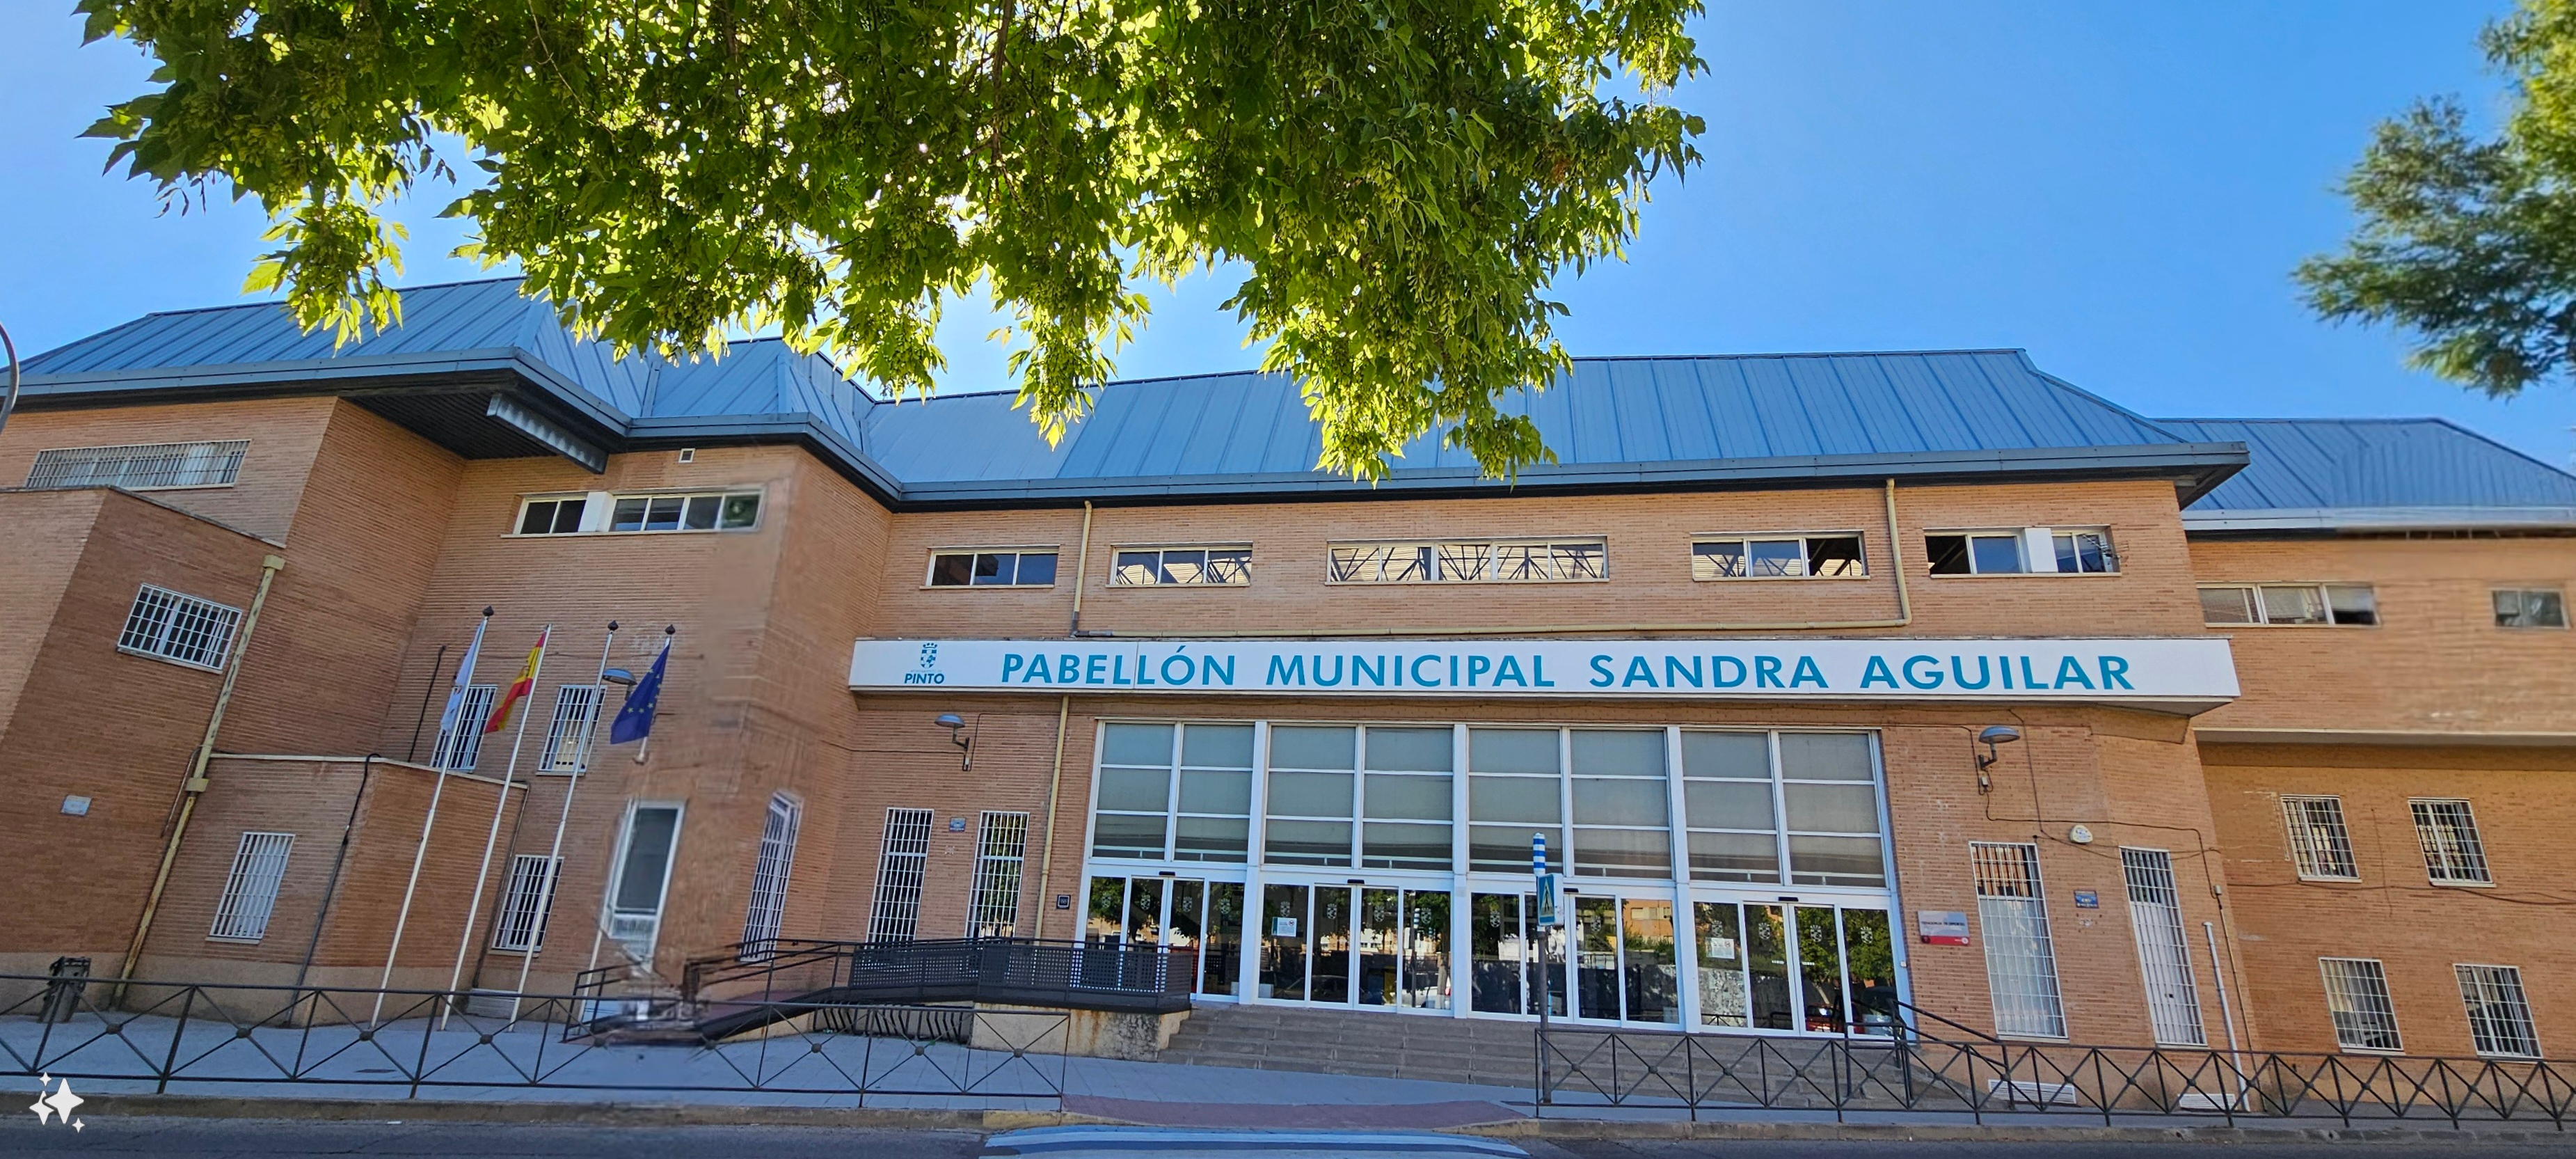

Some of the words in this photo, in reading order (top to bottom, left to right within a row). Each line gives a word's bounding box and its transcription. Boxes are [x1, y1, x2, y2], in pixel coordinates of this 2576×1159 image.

[904, 672, 945, 685] PINTO
[1001, 644, 1235, 686] PABELLÓN
[1265, 654, 1556, 688] MUNICIPAL
[1588, 654, 1830, 689] SANDRA
[1859, 654, 2135, 691] AGUILAR
